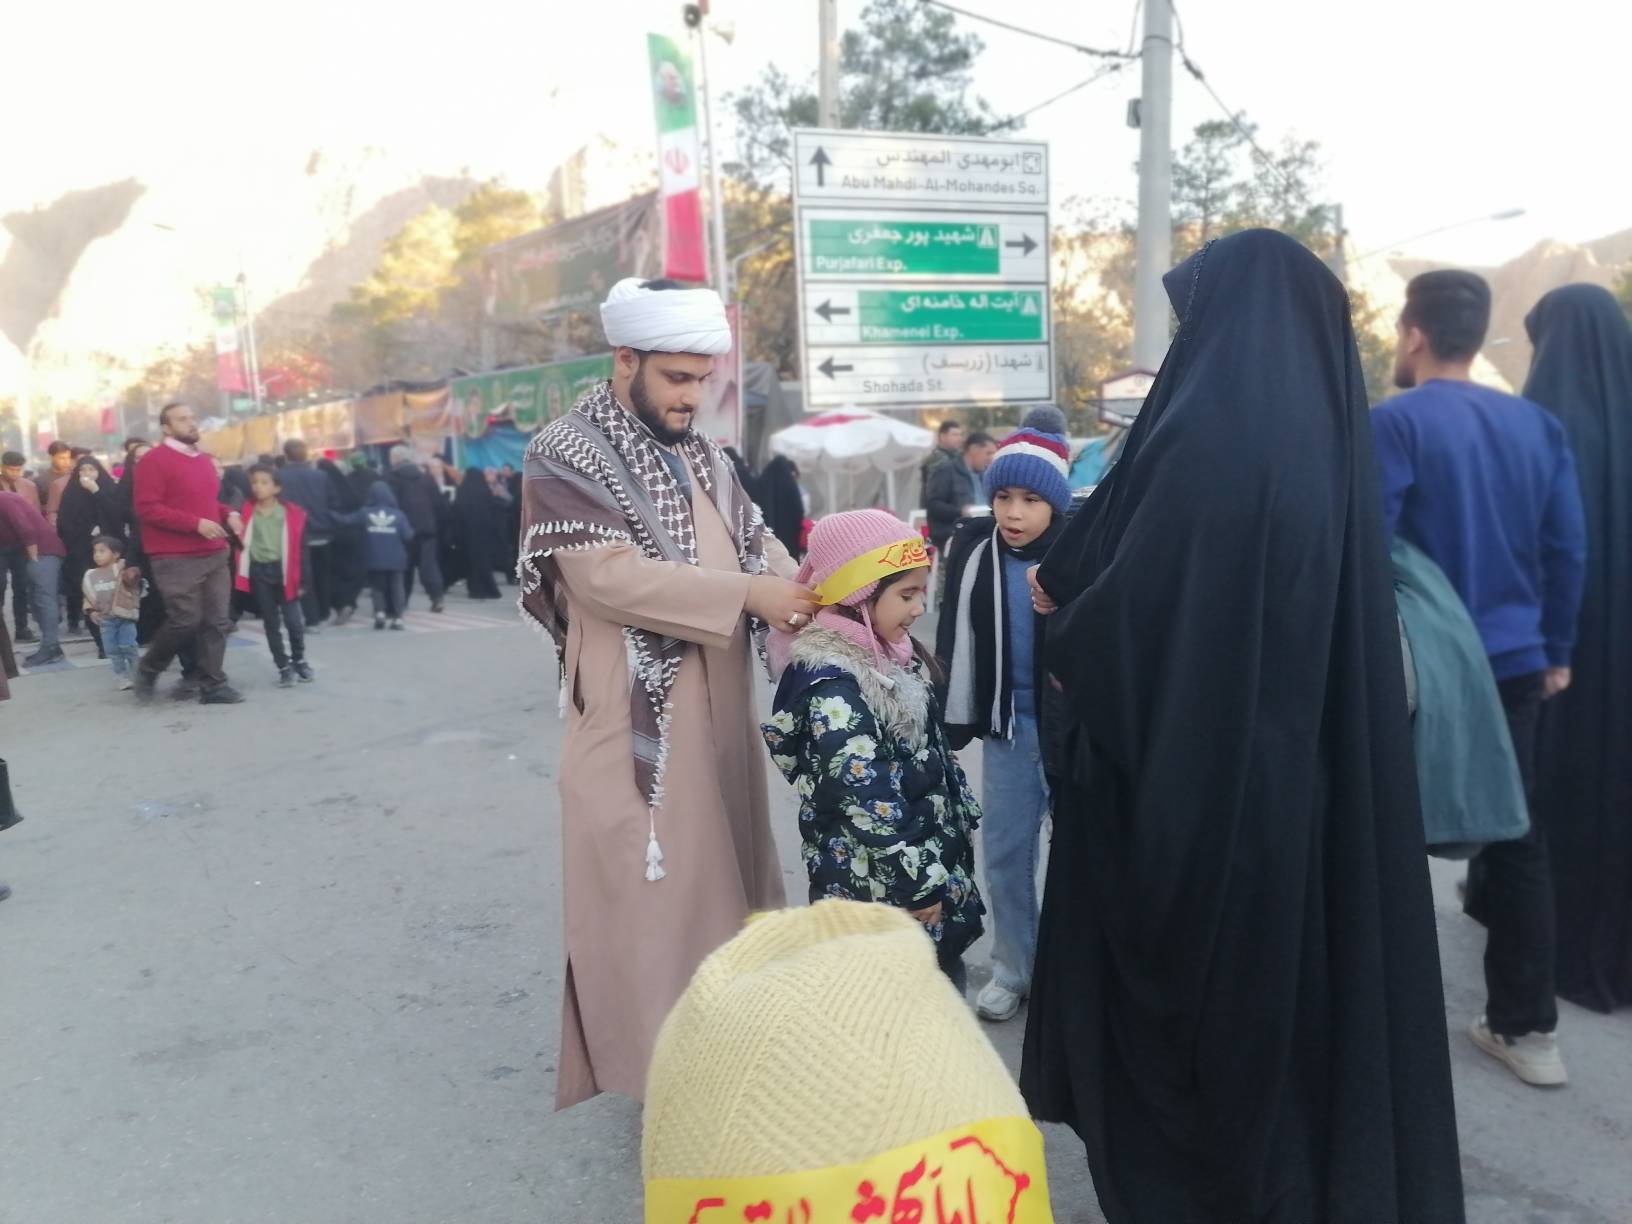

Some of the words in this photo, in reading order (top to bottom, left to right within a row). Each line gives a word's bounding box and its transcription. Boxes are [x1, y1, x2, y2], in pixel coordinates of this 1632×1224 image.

[841, 175, 870, 190] Abu
[1018, 181, 1040, 196] Sq.
[933, 226, 976, 243] شهید
[816, 256, 874, 272] Purjafari
[877, 257, 907, 273] Exp.
[862, 325, 931, 338] Khamenei
[933, 326, 964, 340] Exp.
[864, 379, 924, 393] Shohada
